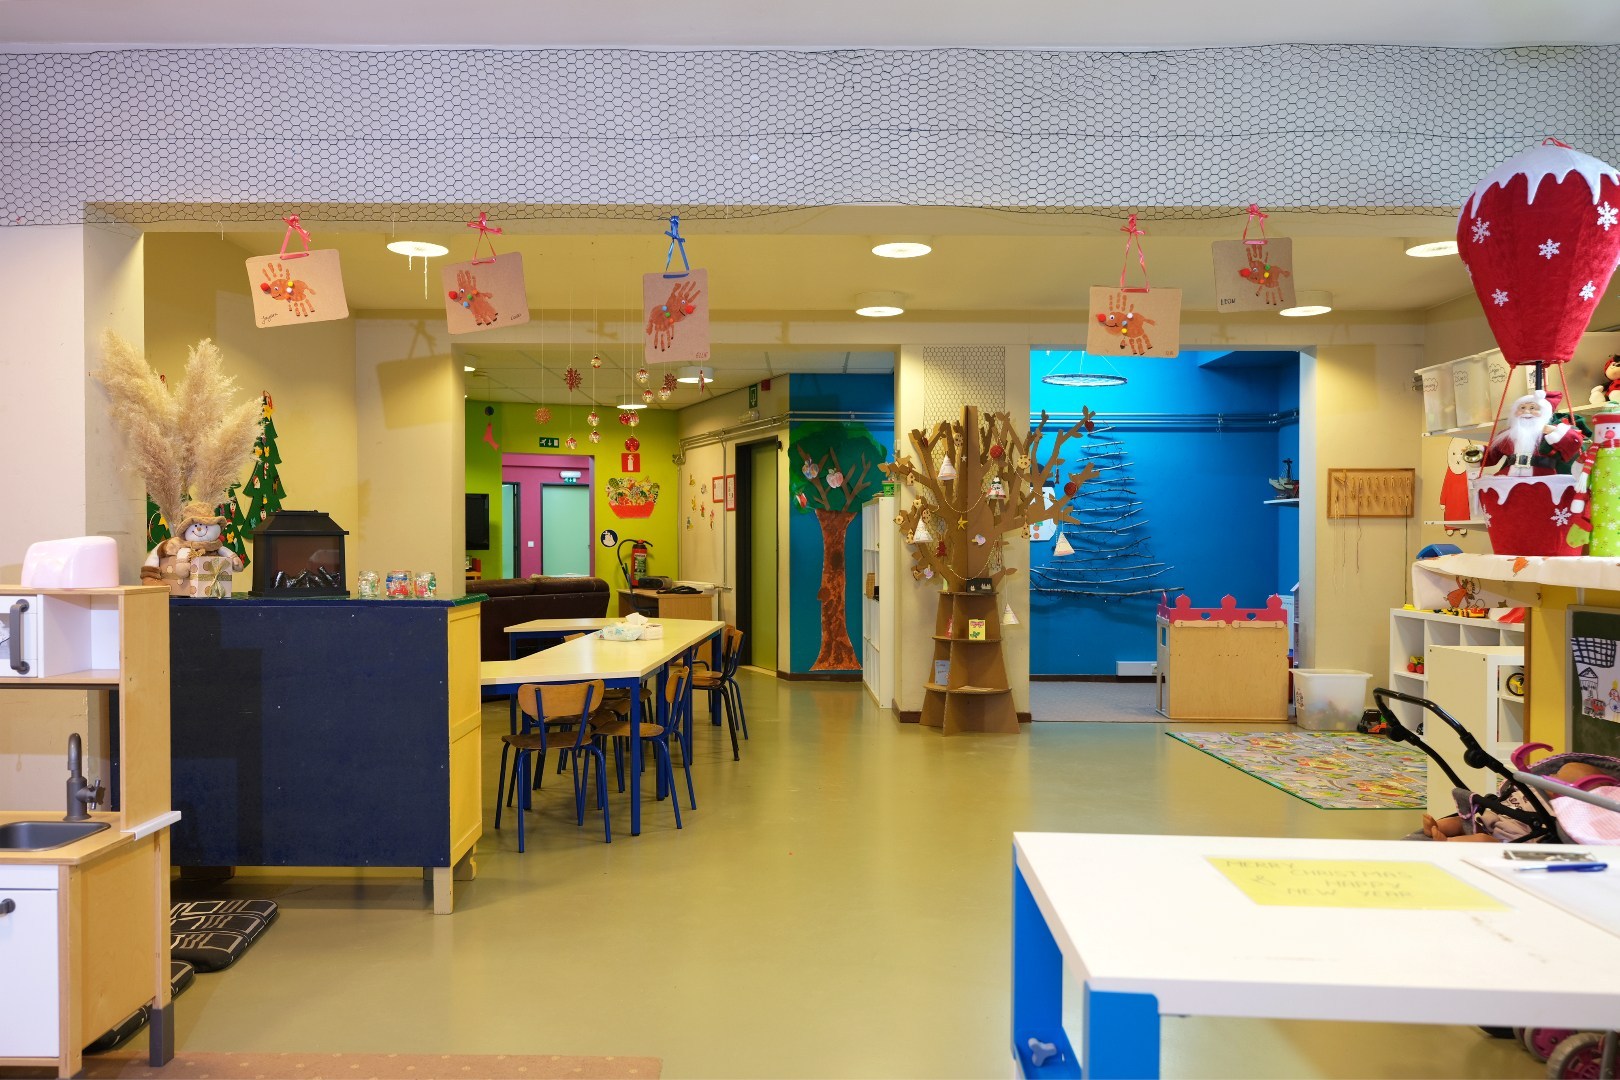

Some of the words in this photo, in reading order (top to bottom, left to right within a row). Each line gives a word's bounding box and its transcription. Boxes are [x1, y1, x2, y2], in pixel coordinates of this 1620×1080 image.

[1225, 860, 1295, 869] MERRY
[1289, 868, 1413, 879] CHRISTMAS
[1324, 878, 1401, 889] HAPPY
[1286, 887, 1337, 896] NEW
[1358, 889, 1415, 898] YEAR
